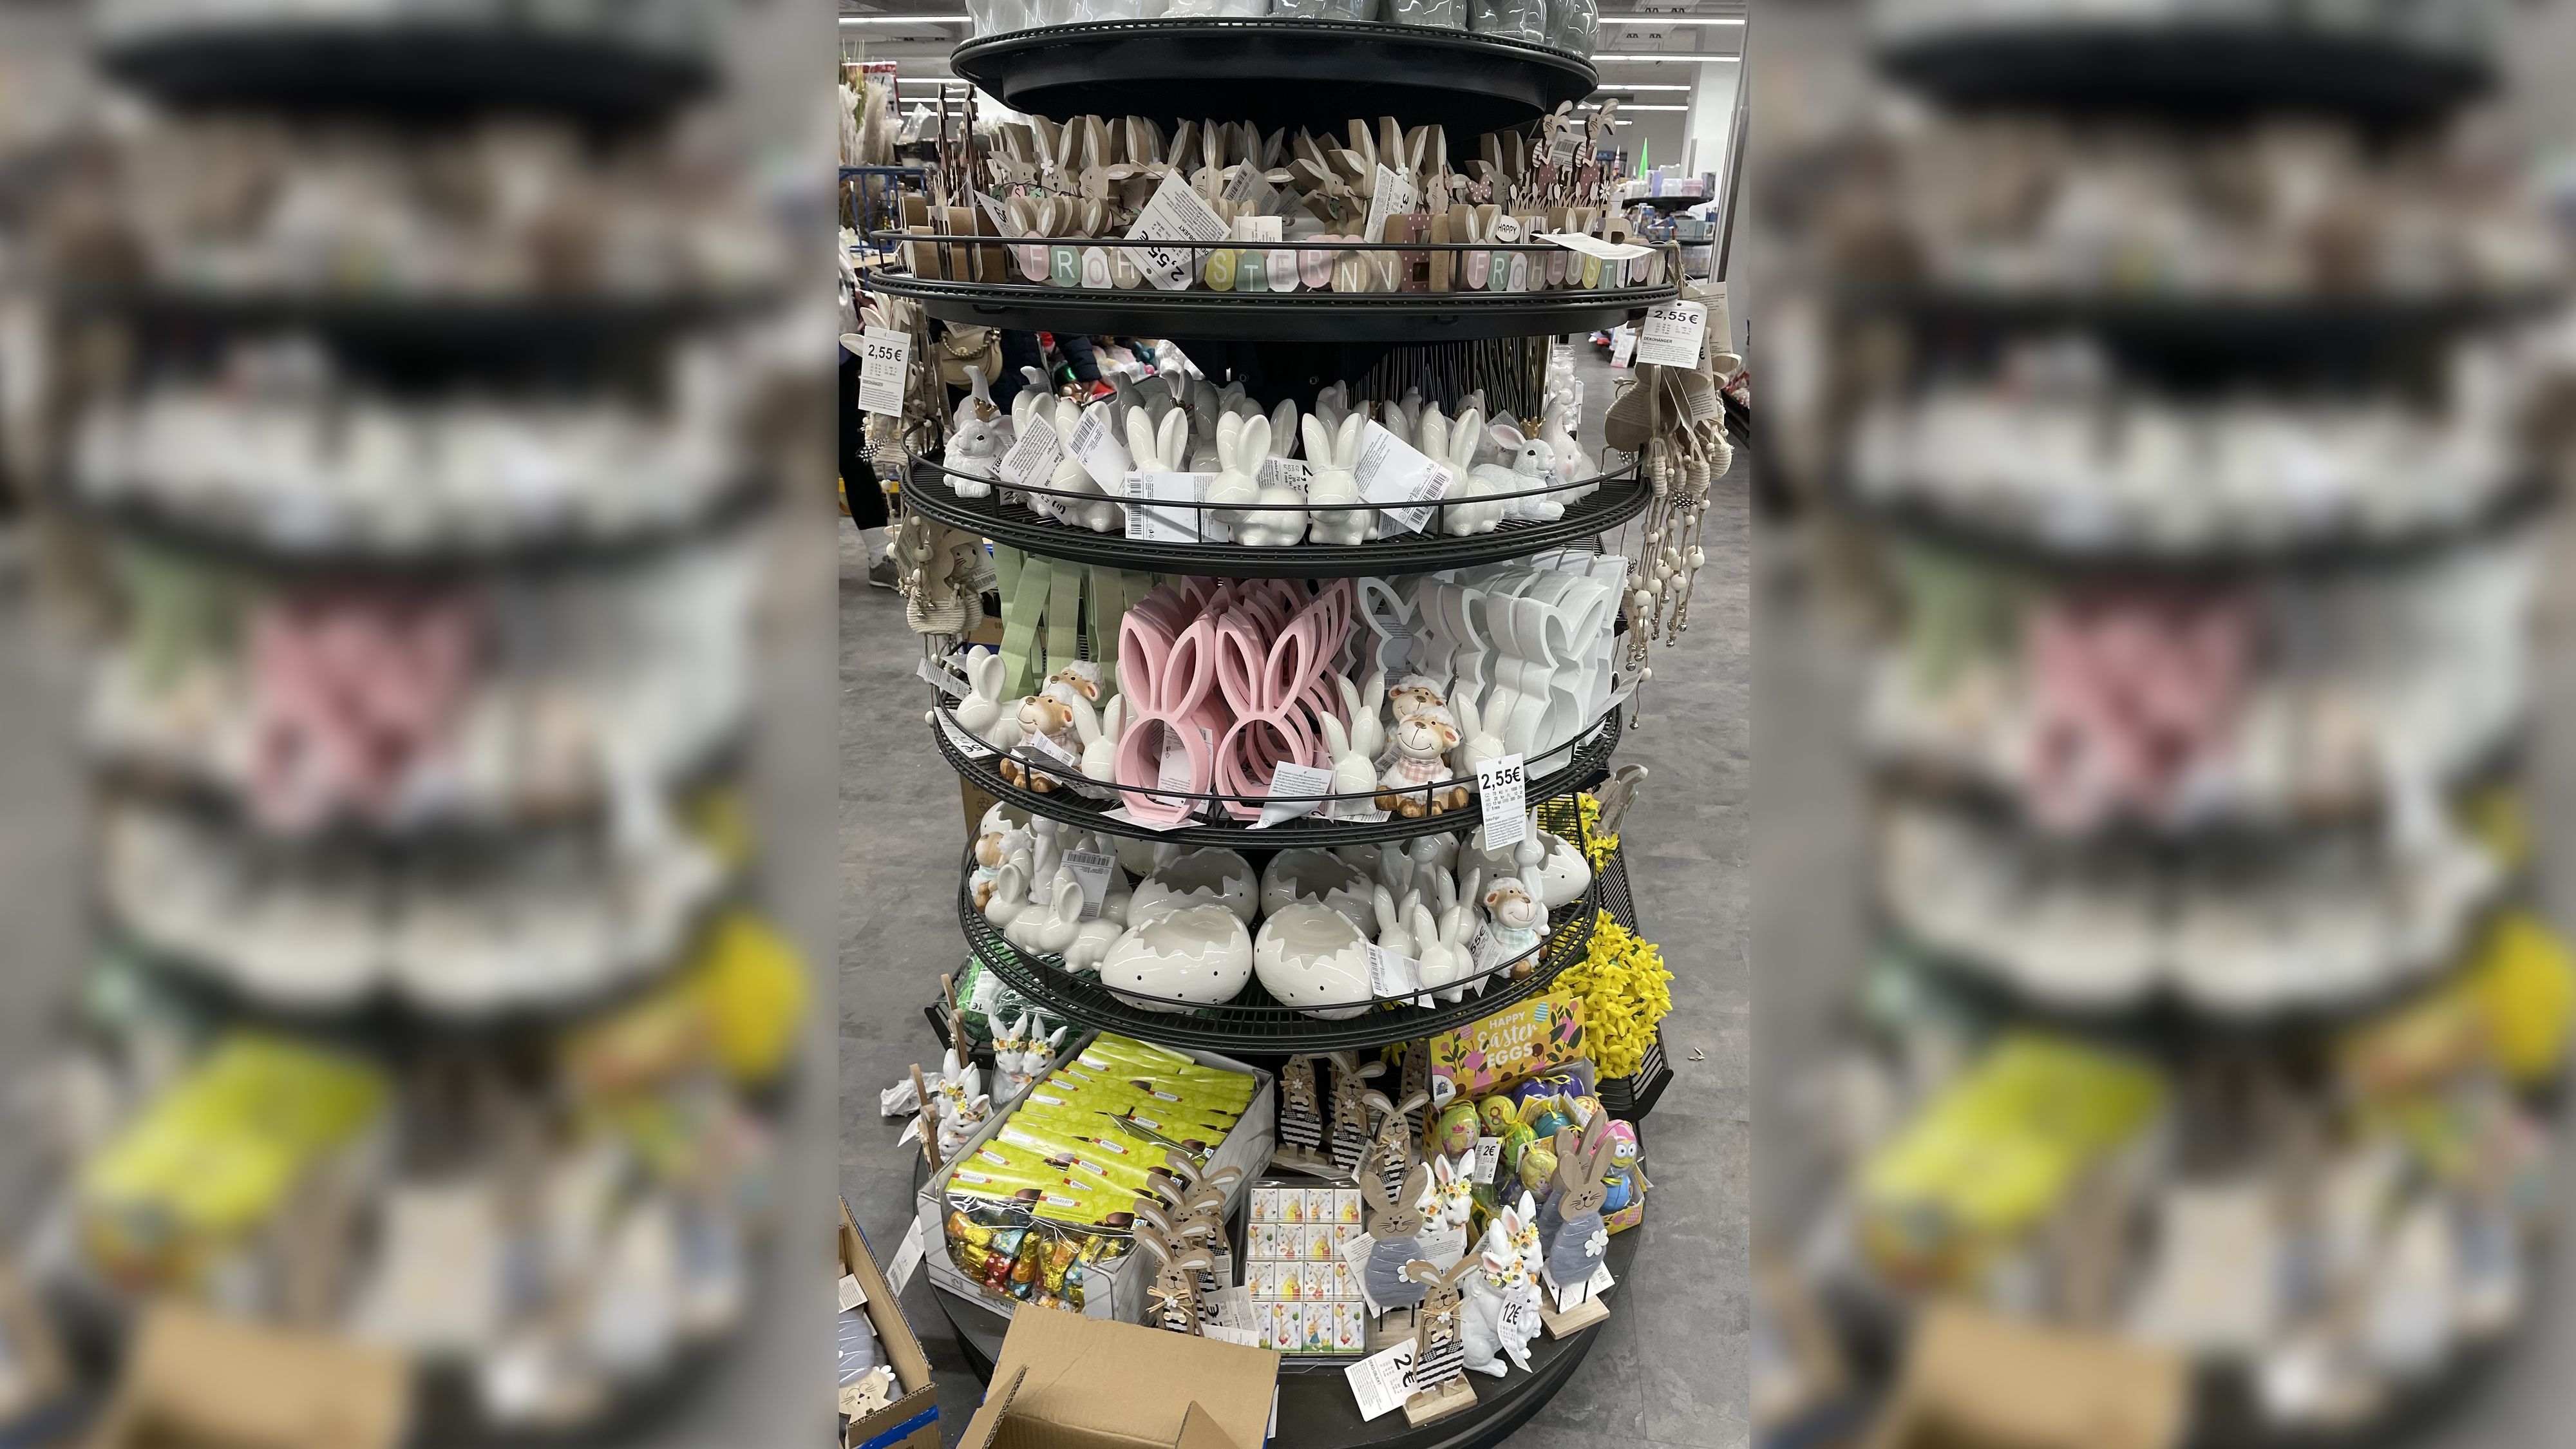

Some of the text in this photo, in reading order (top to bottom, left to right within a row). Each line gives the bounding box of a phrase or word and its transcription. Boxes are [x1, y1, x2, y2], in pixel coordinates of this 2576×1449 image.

[1498, 223, 1517, 234] HAPPY
[1030, 244, 1358, 292] FROH STERN
[1475, 251, 1562, 288] FROHE
[1653, 310, 1699, 324] 2,55€
[867, 345, 902, 362] 2,55€
[1481, 766, 1521, 791] 2,55€
[1470, 926, 1486, 954] 55€
[971, 1002, 983, 1011] 1€
[1489, 1011, 1526, 1030] HAPPY
[1477, 1023, 1539, 1054] Easter
[1486, 1042, 1533, 1069] EGGS
[1102, 1141, 1122, 1151] RIEGELEIN
[1483, 1145, 1496, 1157] 2€
[1081, 1161, 1101, 1173] RIEGELEIN
[1049, 1196, 1074, 1204] RIEGELEIN
[1502, 1302, 1522, 1325] 12€
